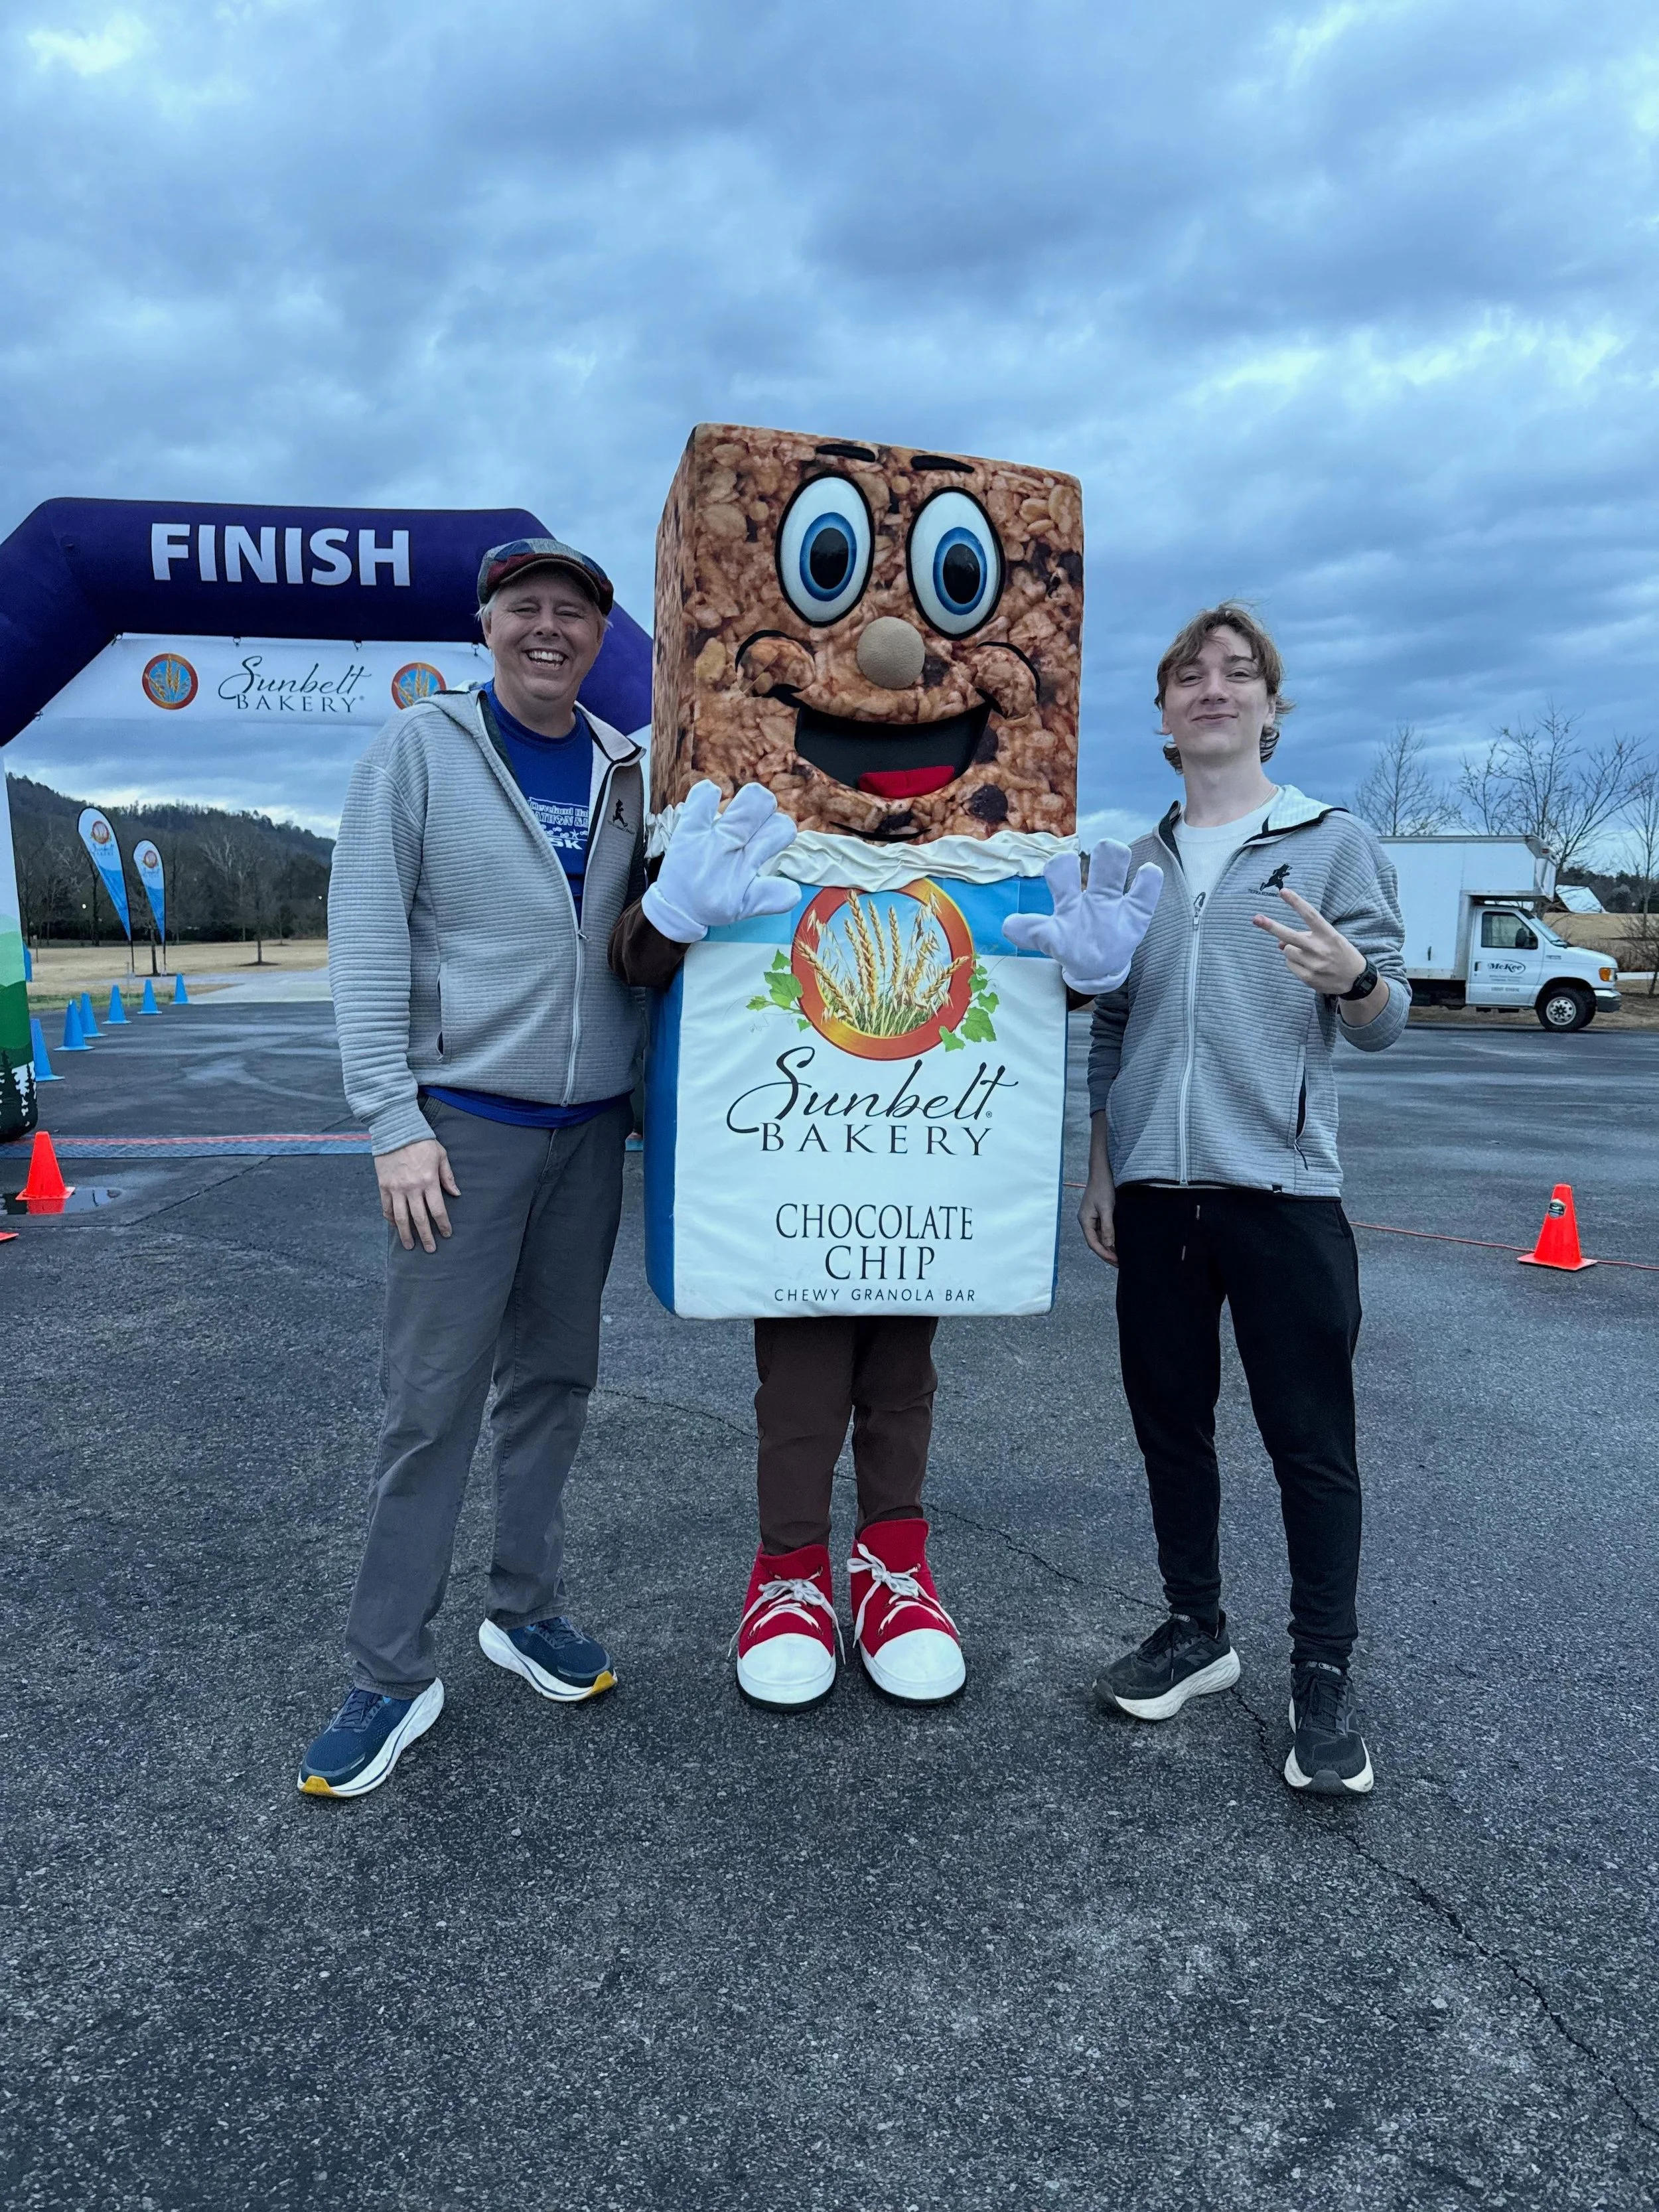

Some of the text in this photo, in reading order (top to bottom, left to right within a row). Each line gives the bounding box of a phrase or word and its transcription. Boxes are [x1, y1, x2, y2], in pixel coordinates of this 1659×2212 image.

[151, 523, 411, 587] FINISH
[218, 656, 372, 700] Sunbelt
[236, 694, 356, 713] BAKERY
[1487, 963, 1522, 973] McKee
[726, 1046, 1019, 1134] Sunbelt
[760, 1122, 992, 1156] BAKERY
[776, 1203, 974, 1240] CHOCOLATE
[825, 1244, 935, 1281] CHIP
[774, 1288, 975, 1301] CHEWY GRANOLA BAR
